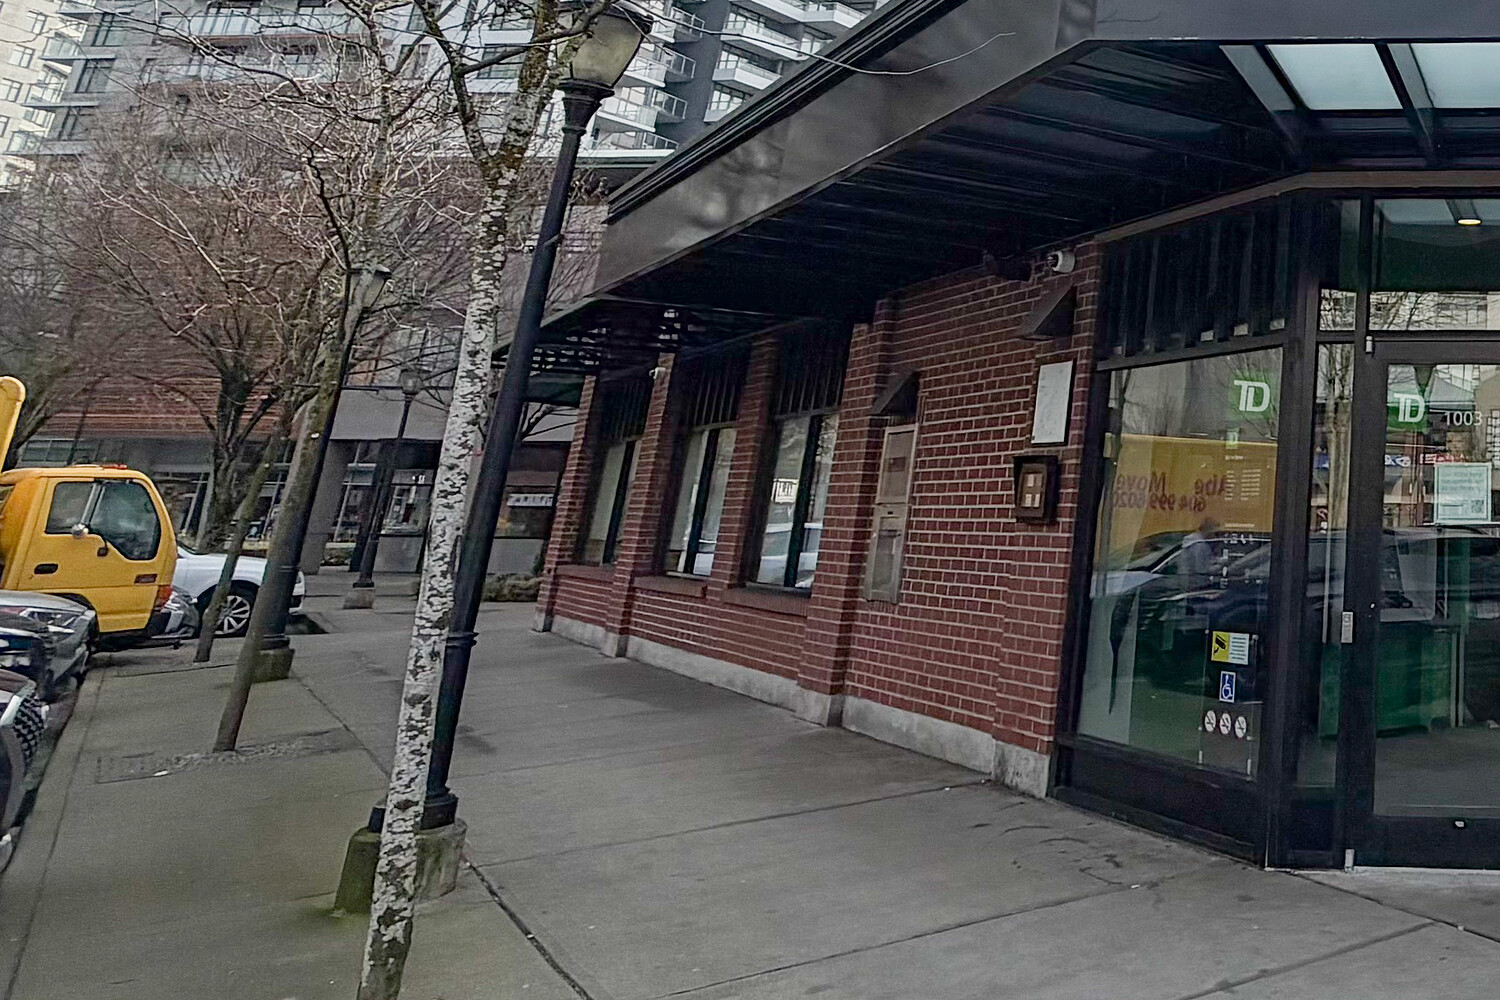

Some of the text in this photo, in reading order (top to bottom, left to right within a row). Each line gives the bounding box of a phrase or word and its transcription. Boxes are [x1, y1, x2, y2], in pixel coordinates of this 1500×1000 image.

[1234, 380, 1270, 412] TD
[1393, 393, 1425, 422] TD
[1444, 411, 1483, 425] 1003
